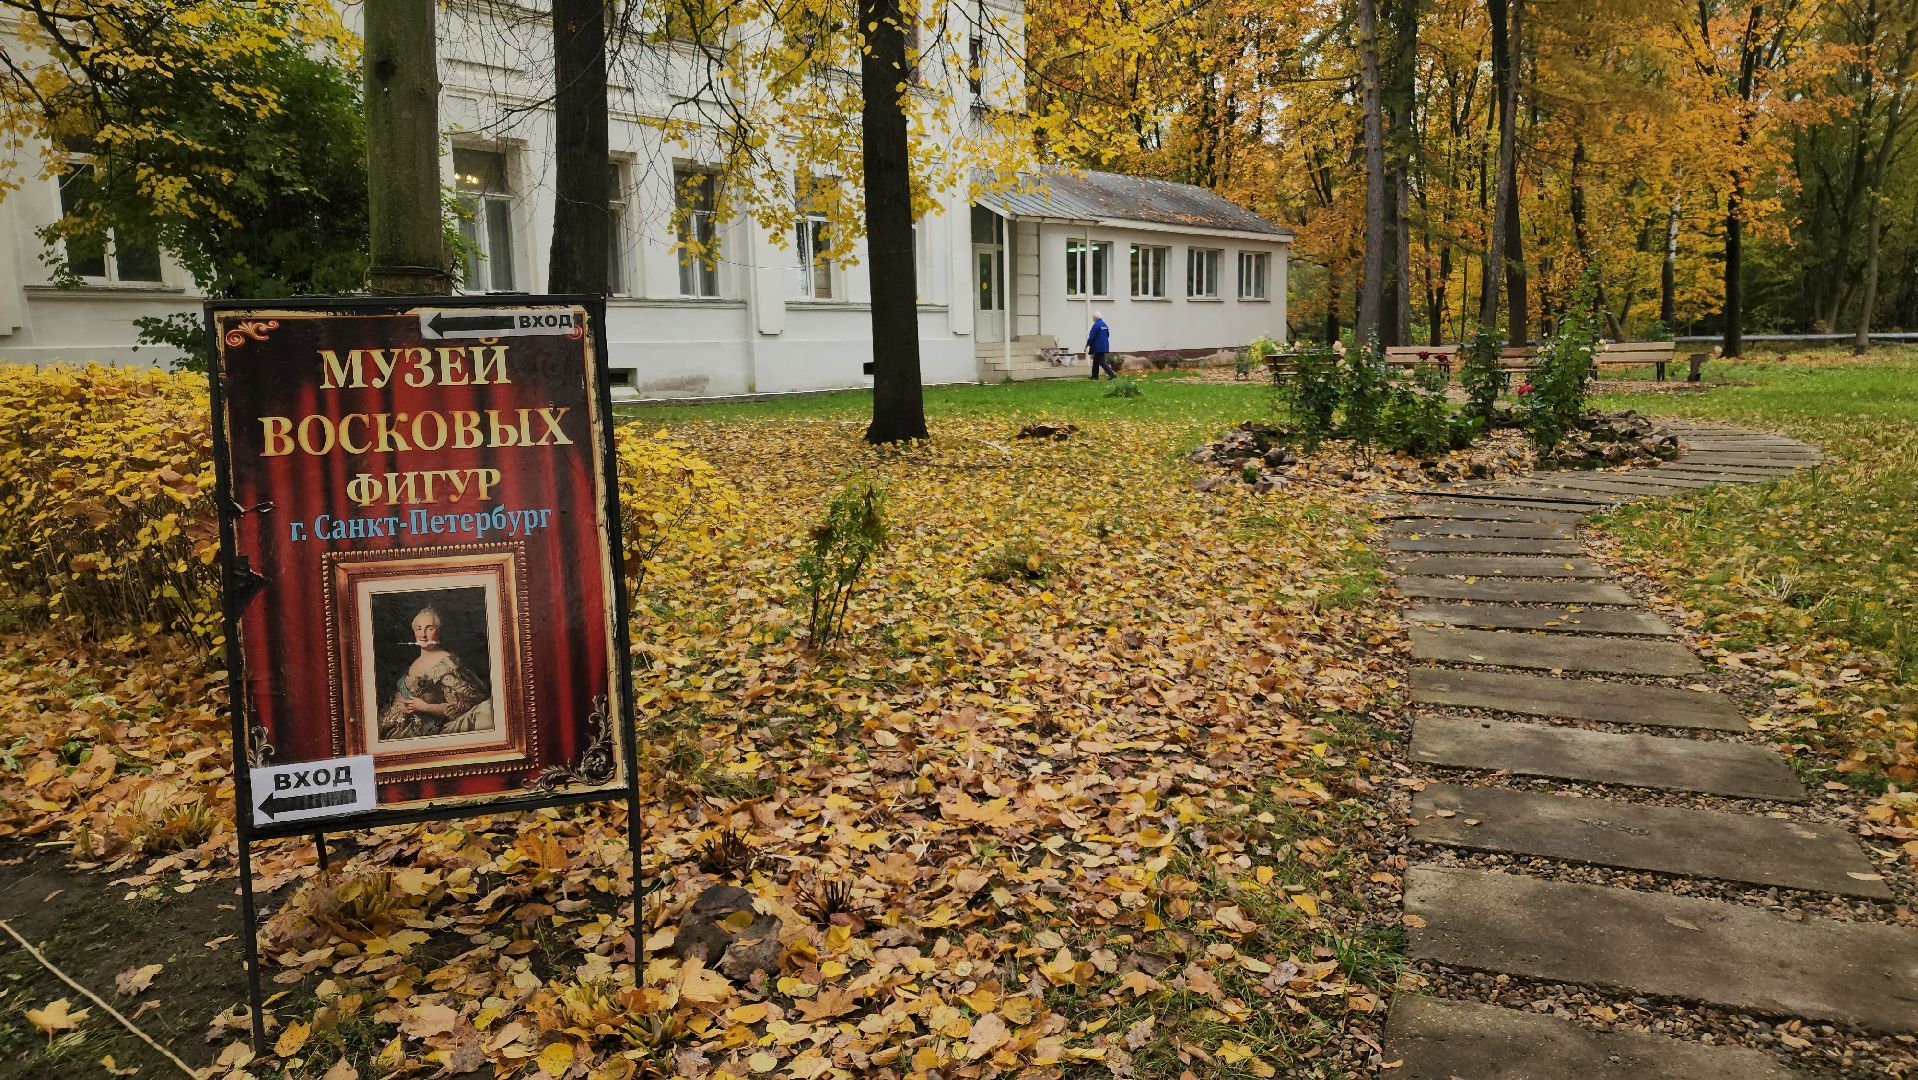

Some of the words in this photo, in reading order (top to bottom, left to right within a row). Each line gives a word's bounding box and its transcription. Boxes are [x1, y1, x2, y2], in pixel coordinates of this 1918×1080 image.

[519, 313, 574, 329] ВХОД
[318, 337, 512, 389] МУЗЕЙ
[258, 407, 574, 456] ВОСКОВЫХ
[346, 468, 501, 507] ФИГУР
[290, 521, 307, 541] г.
[314, 504, 552, 541] Санкт-Петербург
[273, 765, 353, 791] ВХОД
